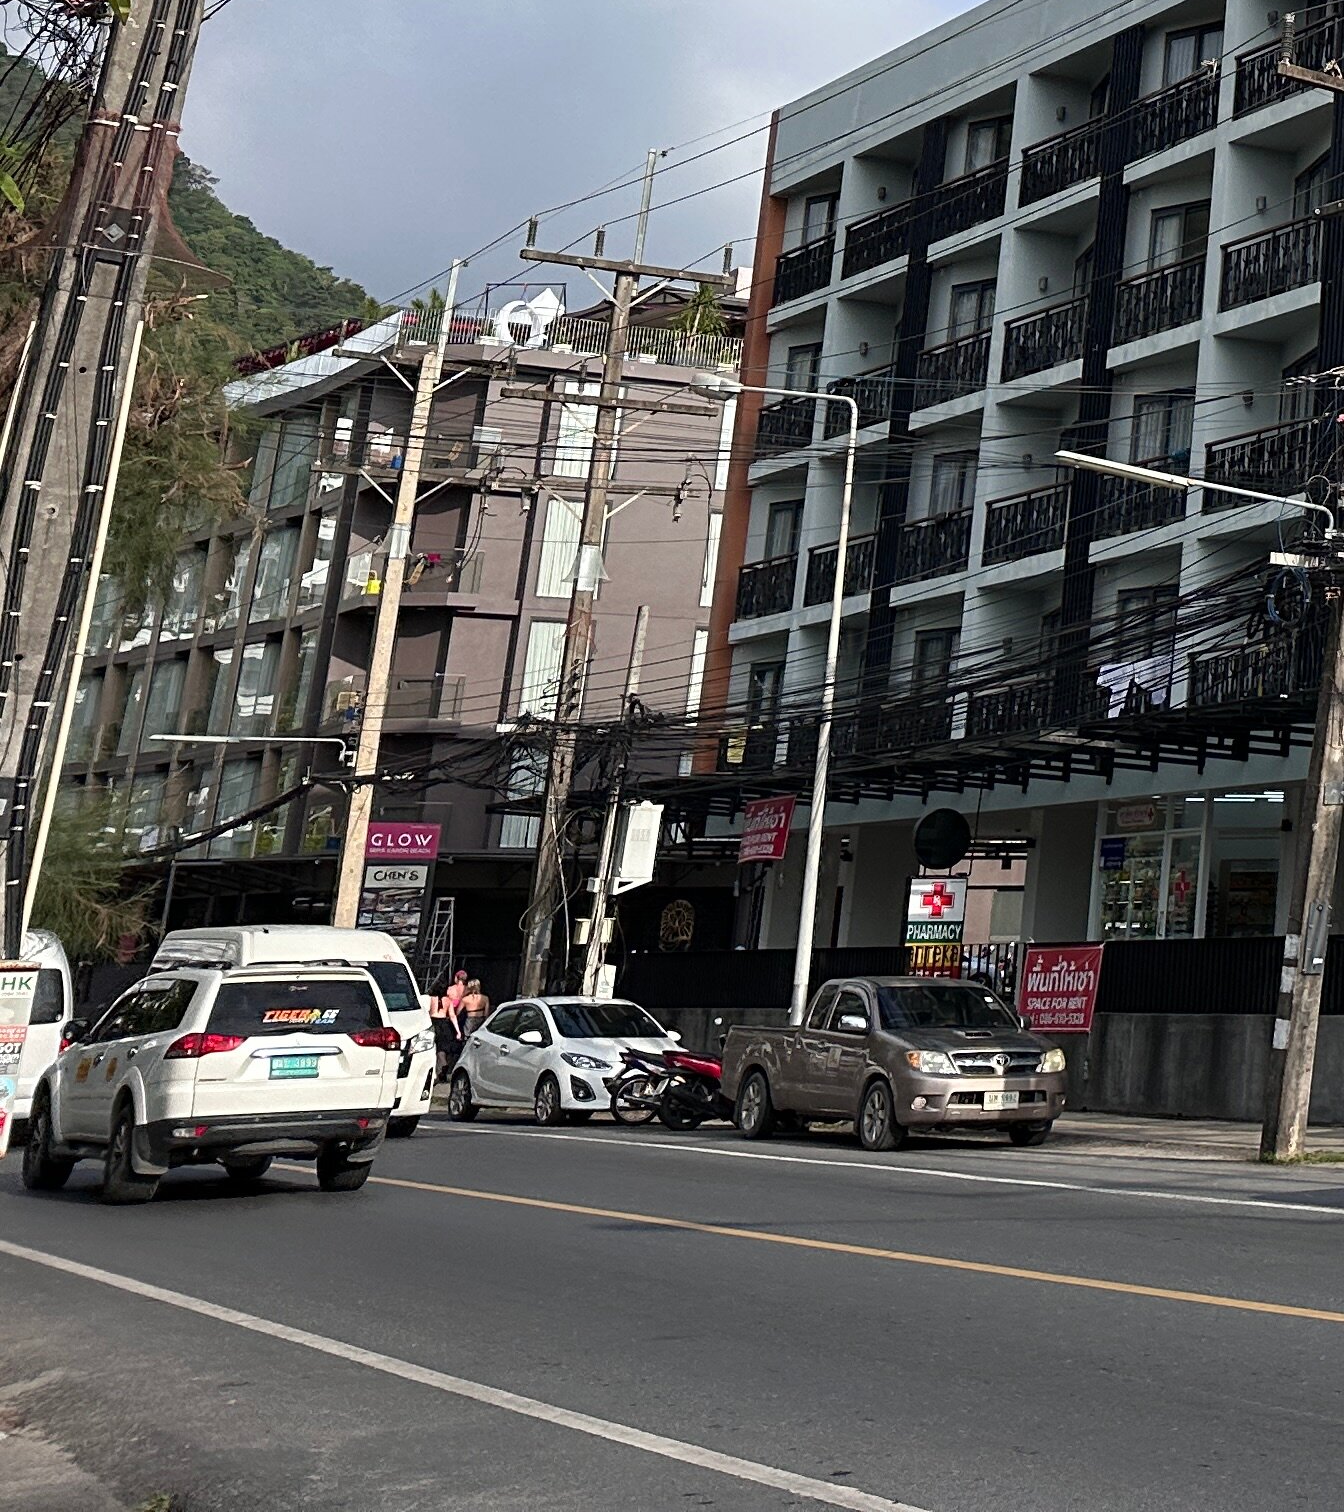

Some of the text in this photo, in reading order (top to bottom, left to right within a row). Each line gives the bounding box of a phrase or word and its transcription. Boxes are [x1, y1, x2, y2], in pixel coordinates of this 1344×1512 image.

[371, 833, 432, 847] GLOW
[374, 870, 419, 881] CHEN'S
[907, 924, 961, 940] PHARMACY
[1027, 954, 1095, 992] พื้นที่ให้เช่า
[1027, 997, 1051, 1010] SPACE
[1051, 997, 1067, 1009] FOR
